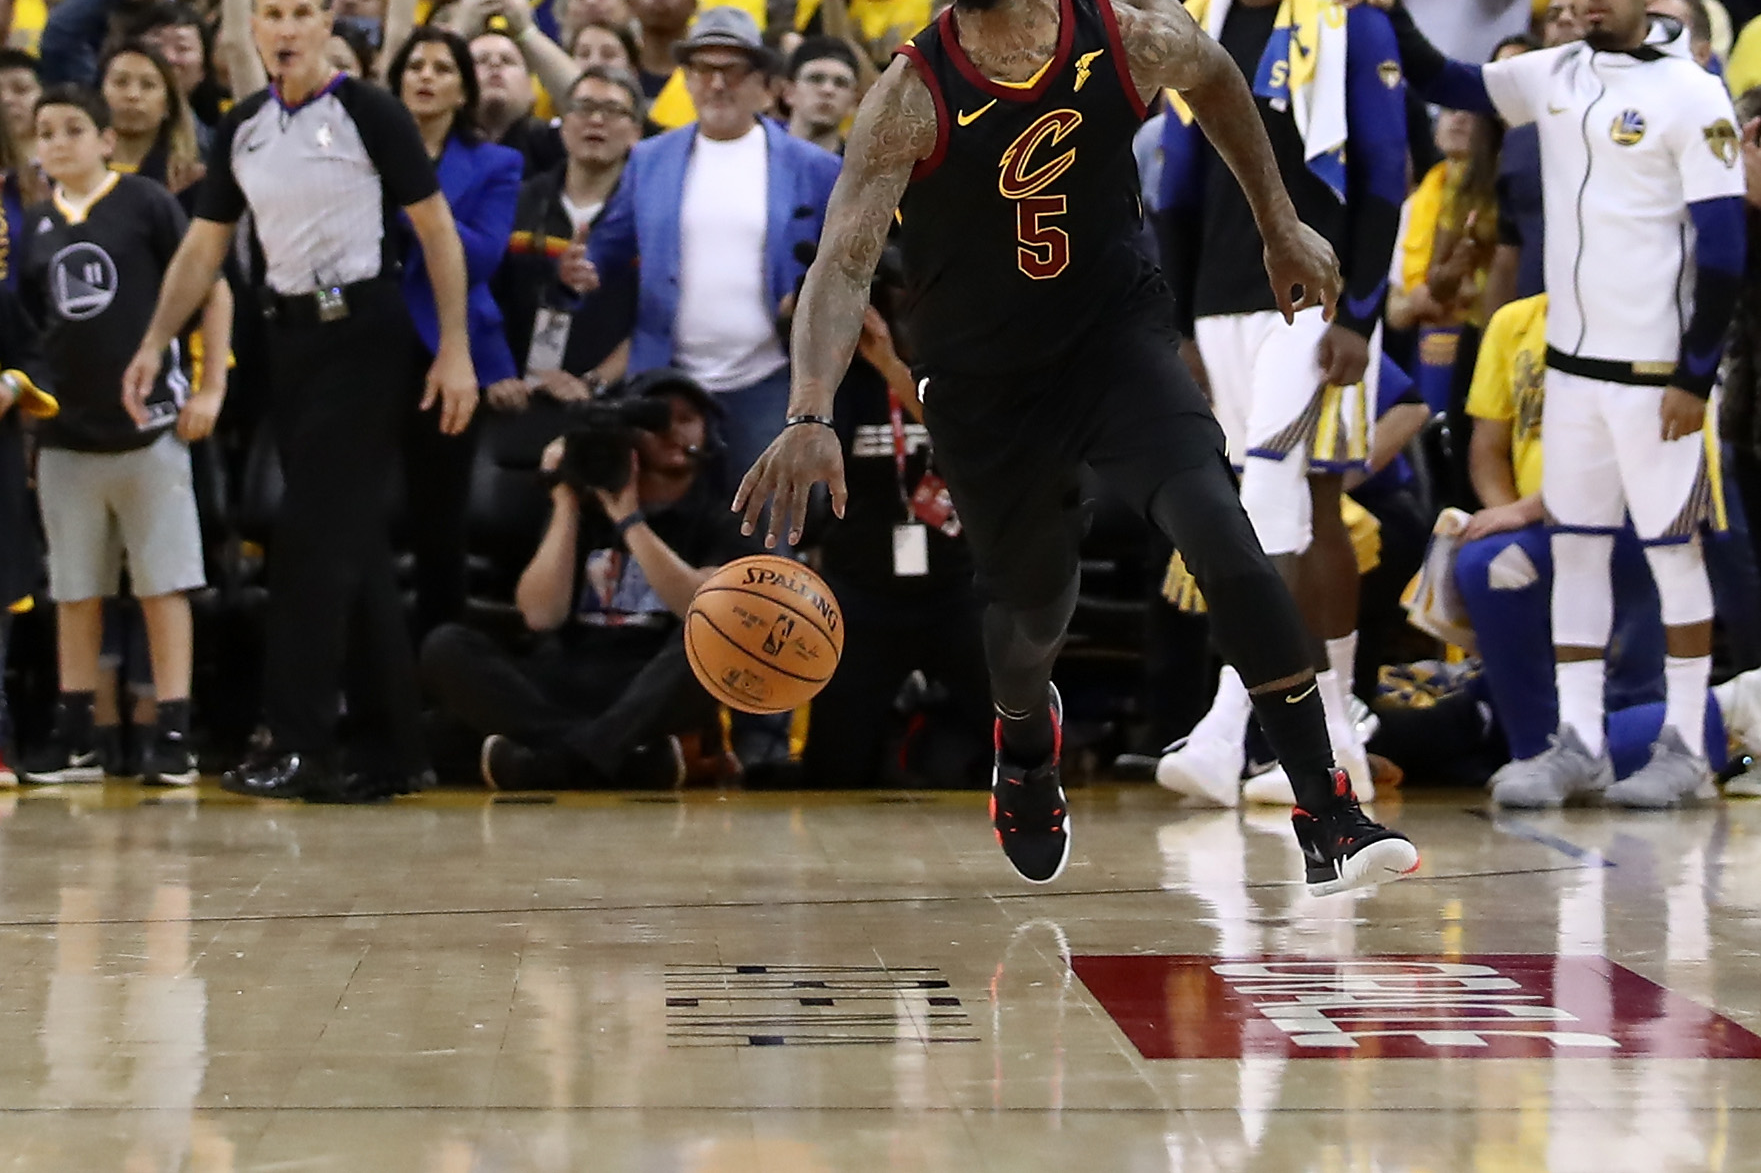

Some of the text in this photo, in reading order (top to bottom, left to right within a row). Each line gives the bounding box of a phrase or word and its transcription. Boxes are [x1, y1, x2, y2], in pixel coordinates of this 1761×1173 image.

[1016, 194, 1071, 281] 5
[742, 566, 839, 633] SPALDING
[1209, 961, 1622, 1048] ORACLE
